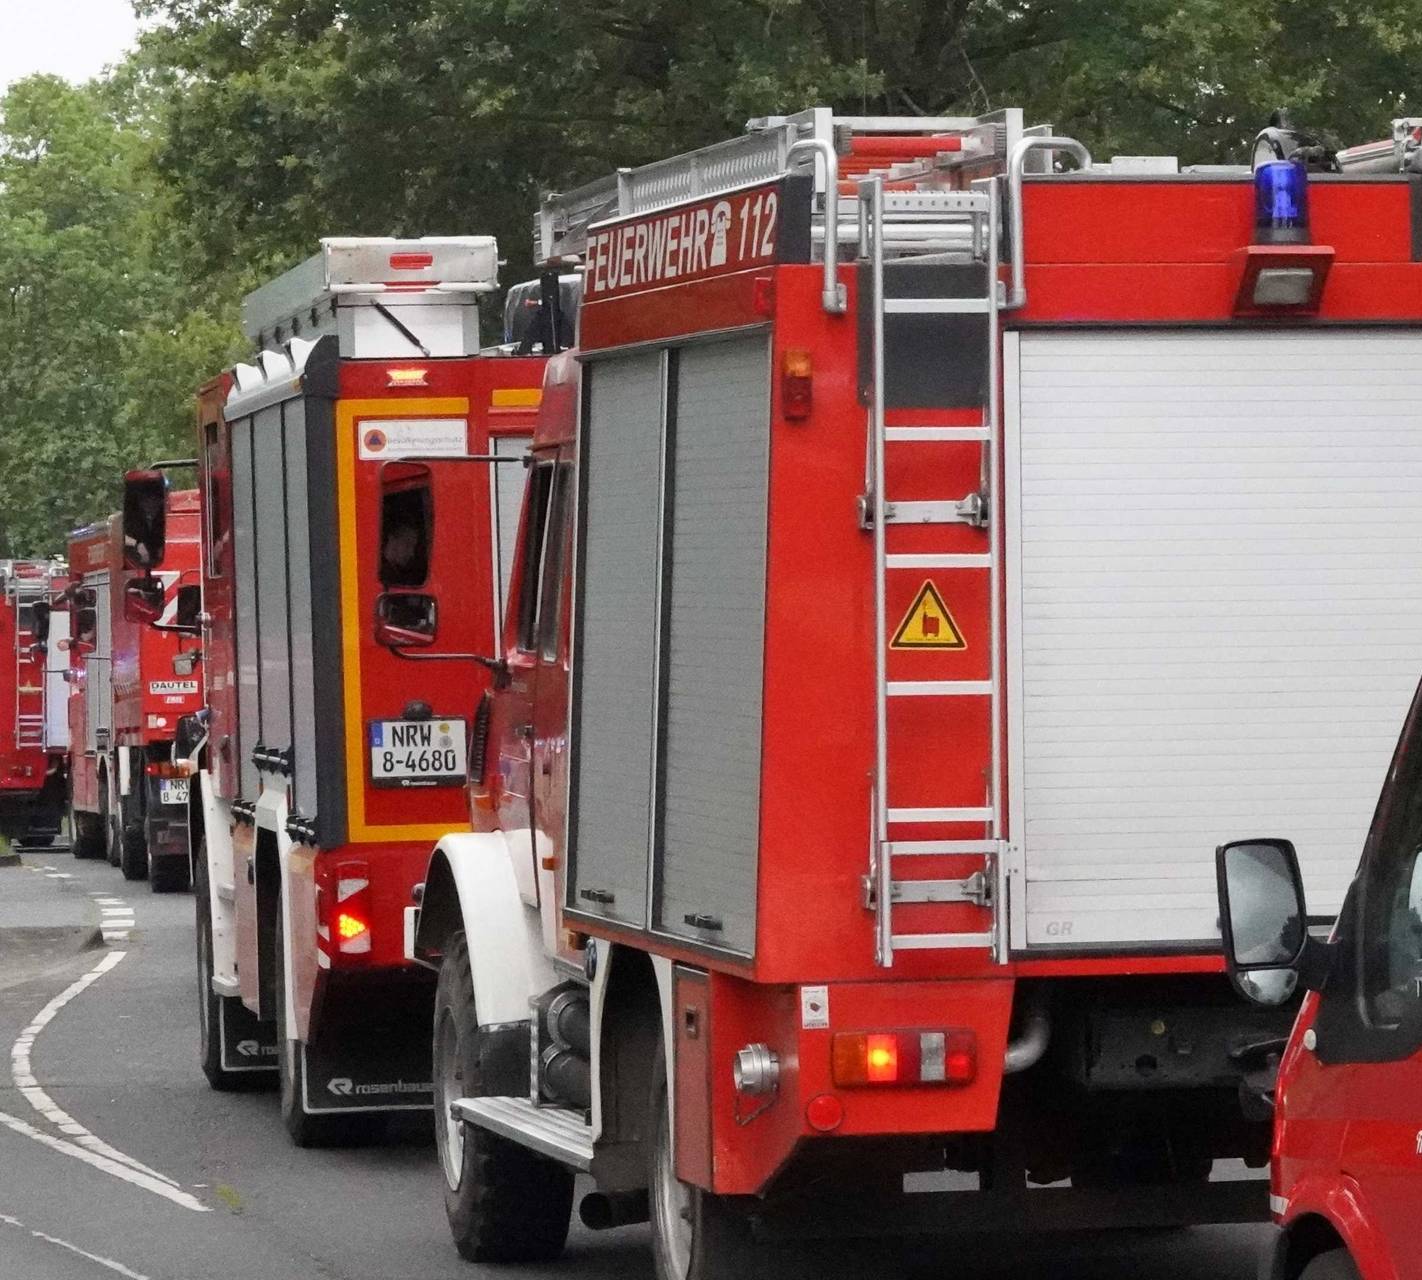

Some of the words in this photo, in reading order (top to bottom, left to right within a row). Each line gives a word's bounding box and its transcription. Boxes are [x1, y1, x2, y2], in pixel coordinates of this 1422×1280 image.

[583, 208, 709, 294] FEUERWEHR
[739, 192, 778, 261] 112
[151, 681, 196, 689] DAUTEL
[391, 724, 432, 748] NRW
[382, 748, 456, 773] 8-4680
